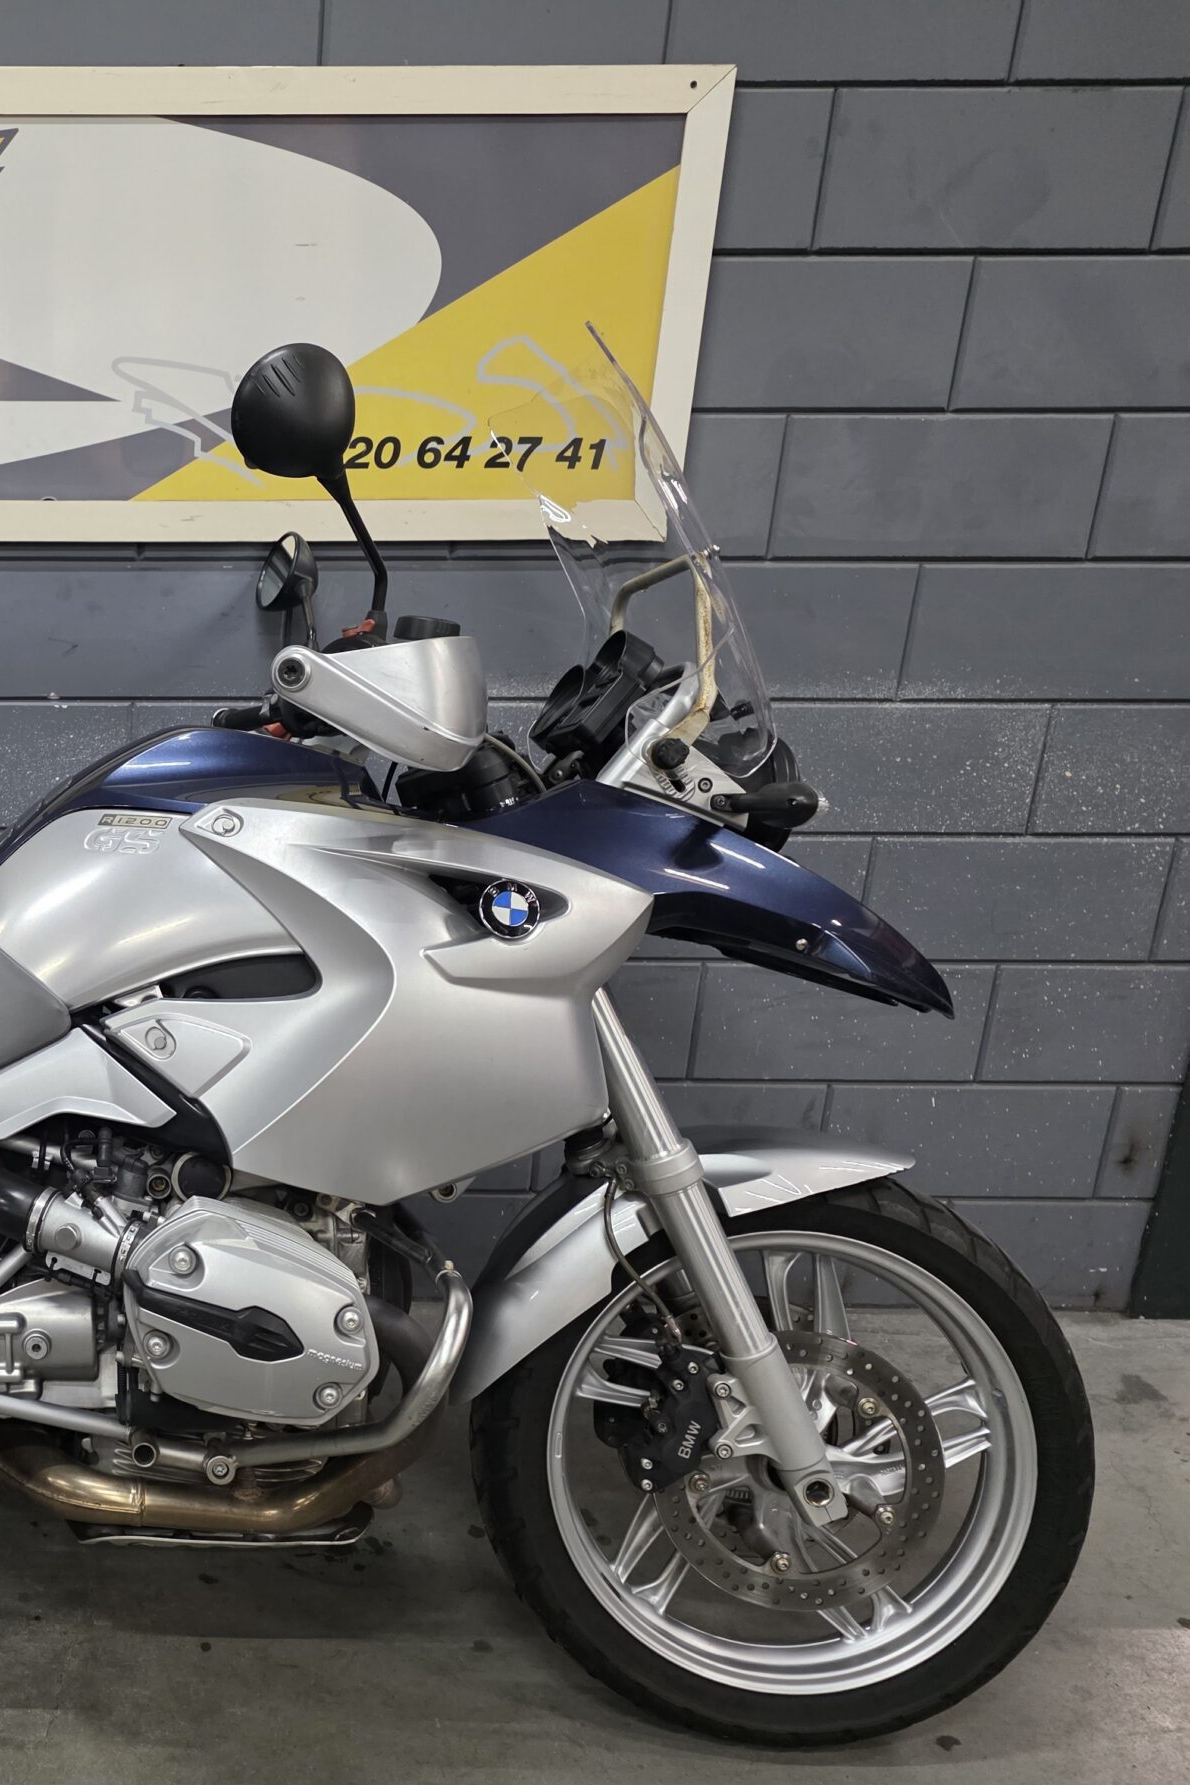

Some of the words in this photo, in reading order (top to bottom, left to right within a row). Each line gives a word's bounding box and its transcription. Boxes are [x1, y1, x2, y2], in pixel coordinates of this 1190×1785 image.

[343, 436, 402, 470] 20
[416, 436, 472, 470] 64
[484, 436, 543, 473] 27
[555, 437, 607, 471] 41
[98, 814, 173, 829] R1200
[83, 827, 166, 855] GS
[677, 1420, 701, 1459] BMW
